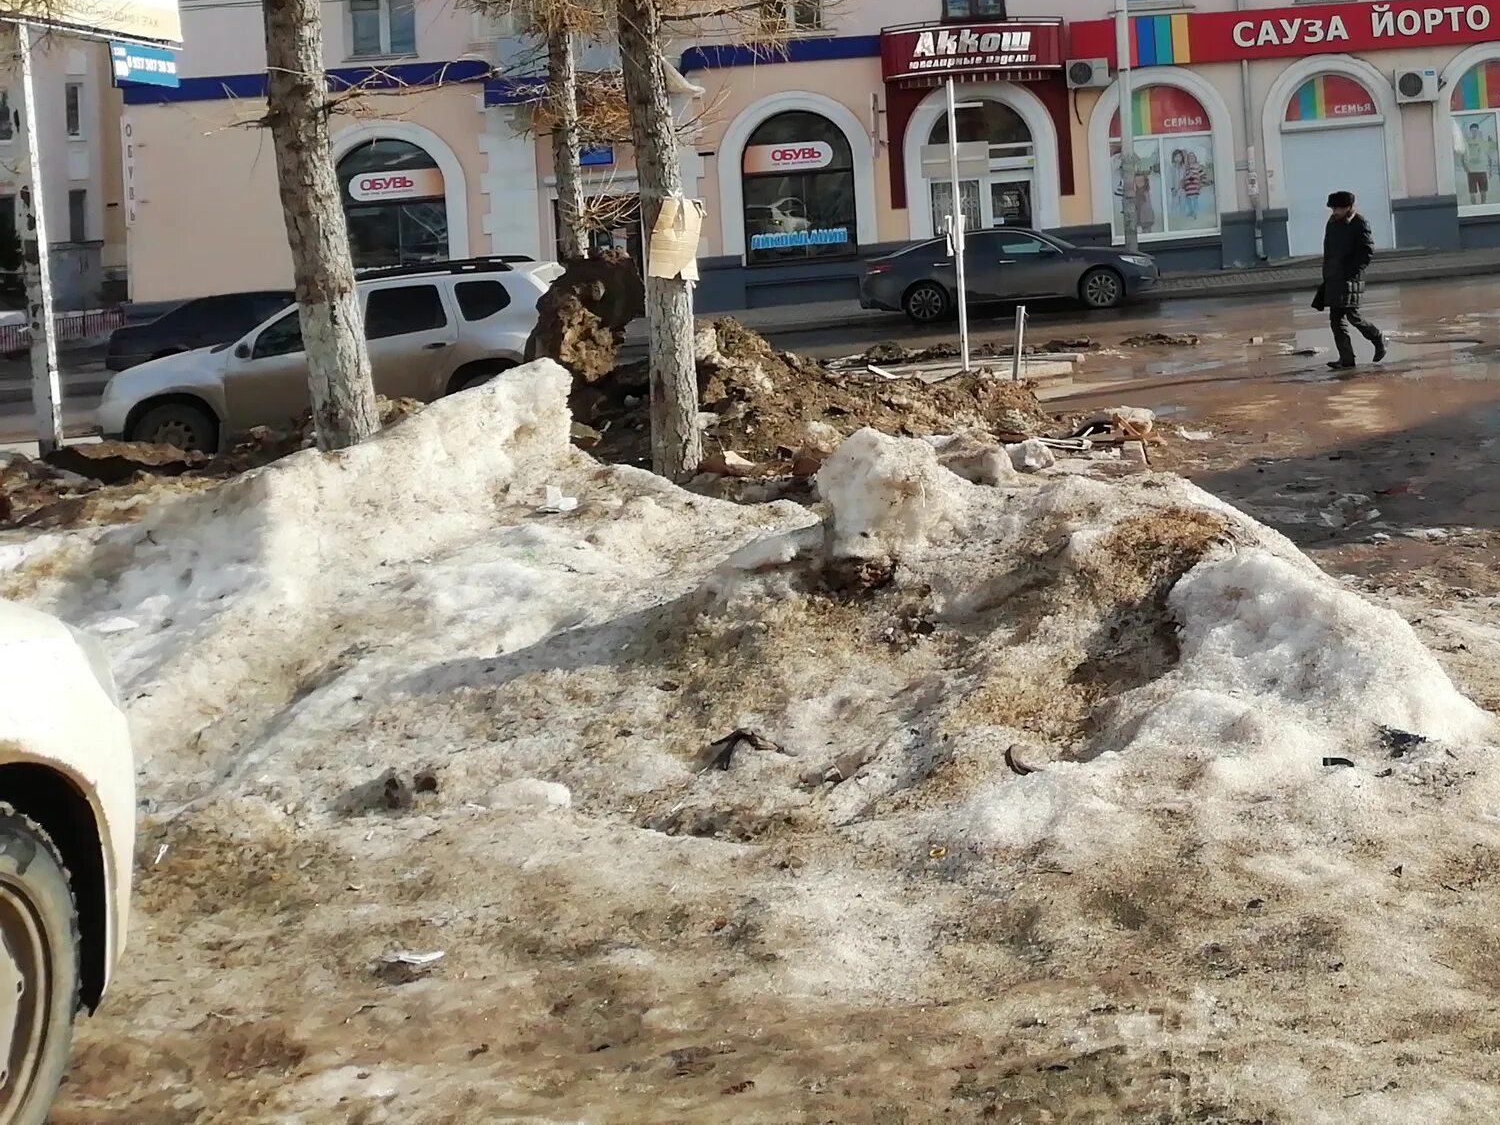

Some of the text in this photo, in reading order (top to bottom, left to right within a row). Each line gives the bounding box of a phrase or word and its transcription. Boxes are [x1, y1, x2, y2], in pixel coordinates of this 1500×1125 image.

[1232, 4, 1491, 48] САУЗА ЙОРТО
[1334, 102, 1372, 114] СЕМЬЯ
[1163, 116, 1203, 128] СЕМЬЯ
[771, 147, 822, 162] ОБУВЬ
[360, 176, 414, 192] ОБУВЬ
